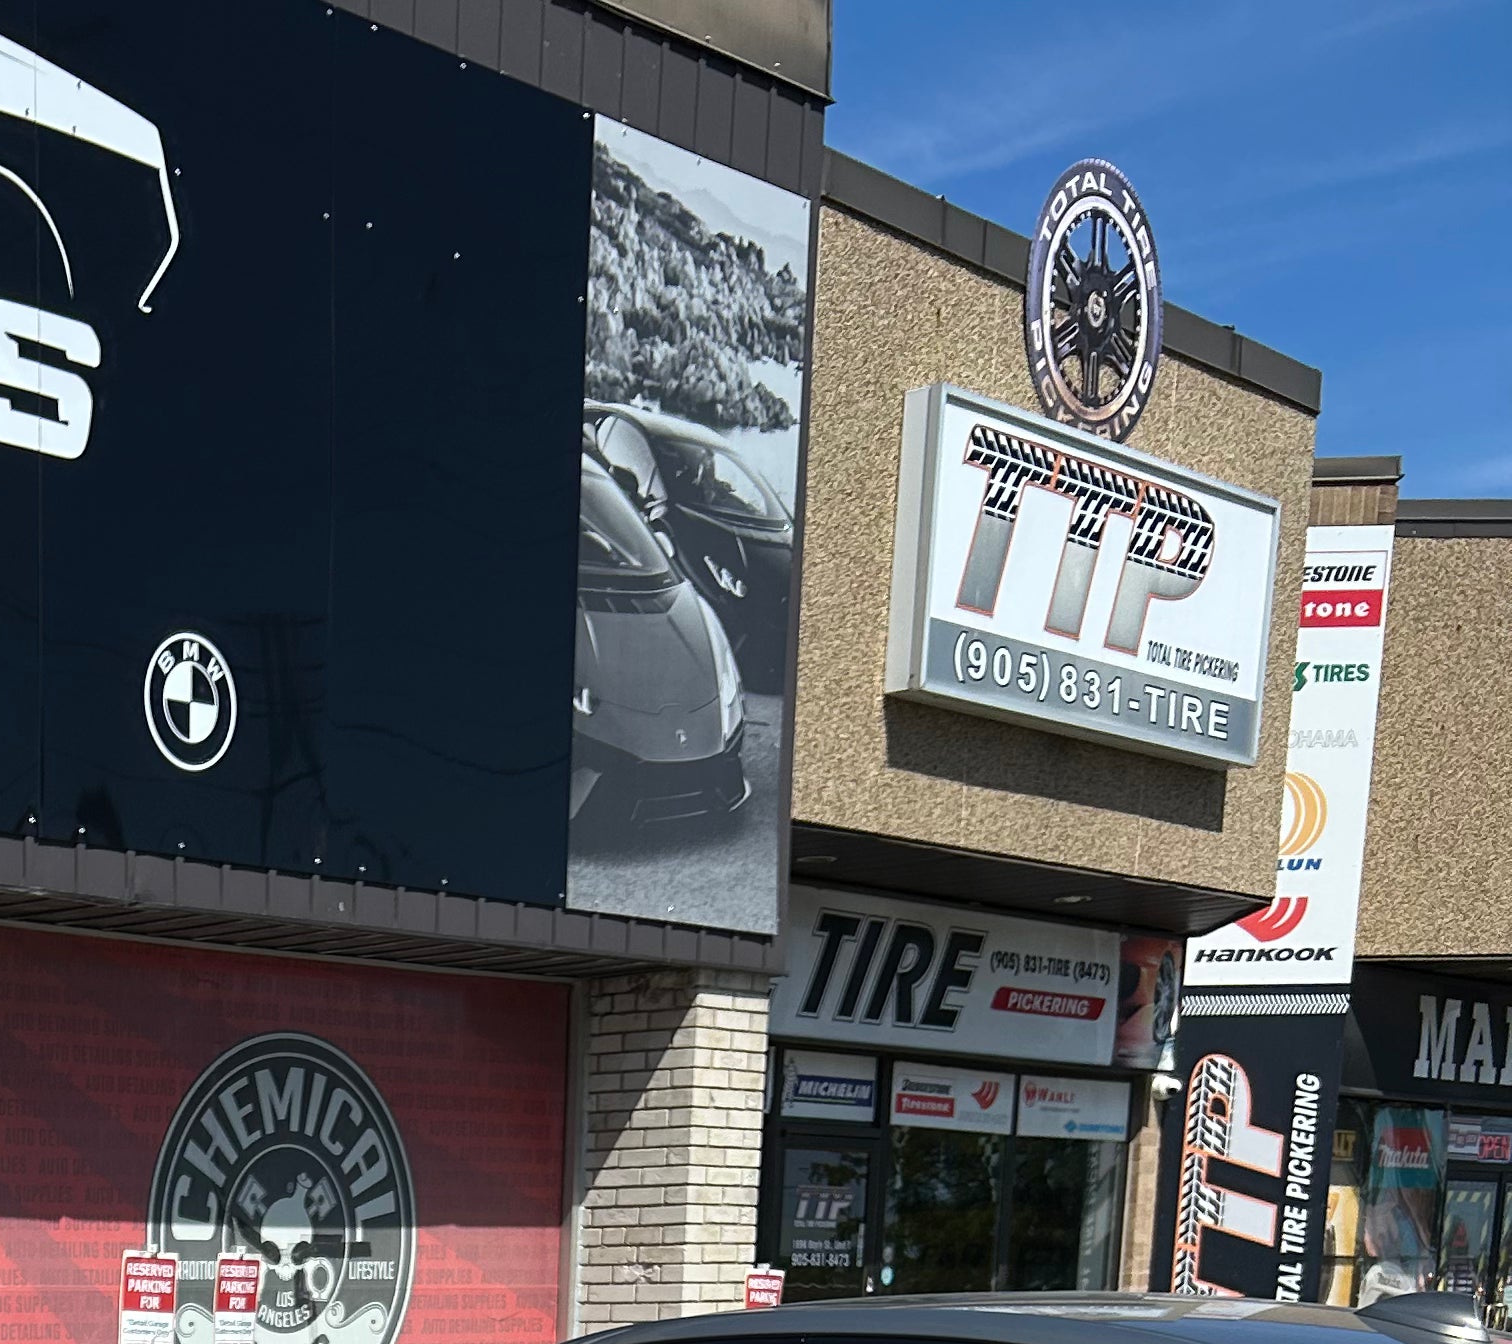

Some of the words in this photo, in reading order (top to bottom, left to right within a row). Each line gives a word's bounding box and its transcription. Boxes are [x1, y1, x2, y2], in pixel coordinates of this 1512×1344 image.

[1039, 171, 1114, 241] TOTAL
[1121, 189, 1158, 290] TIRE
[955, 423, 1216, 657] TTP
[157, 640, 225, 683] BMW
[1147, 640, 1172, 666] TOTAL
[1193, 652, 1241, 683] PICKERING
[1313, 663, 1371, 682] TIRES
[953, 631, 1051, 701] (905)
[1059, 664, 1230, 741] 831-TIRE
[795, 906, 989, 1032] TIRE
[991, 951, 1020, 977] (905)
[1007, 990, 1090, 1016] PICKERING
[798, 1080, 873, 1100] MICHELIN
[1285, 1072, 1322, 1201] PICKERING
[171, 1066, 396, 1243] CHEMICAL
[1280, 1205, 1308, 1254] TIRE
[126, 1262, 174, 1278] RESERVED
[219, 1264, 258, 1278] RESERVED
[348, 1260, 396, 1281] LIFESTYLE
[128, 1279, 173, 1294] PARKING
[220, 1281, 256, 1294] PARKING
[139, 1296, 161, 1310] FOR
[229, 1297, 247, 1310] FOR
[275, 1291, 296, 1308] LOS
[257, 1305, 311, 1330] ANGELES
[497, 1315, 543, 1334] SUPPLIES
[0, 1322, 62, 1341] DETAILING
